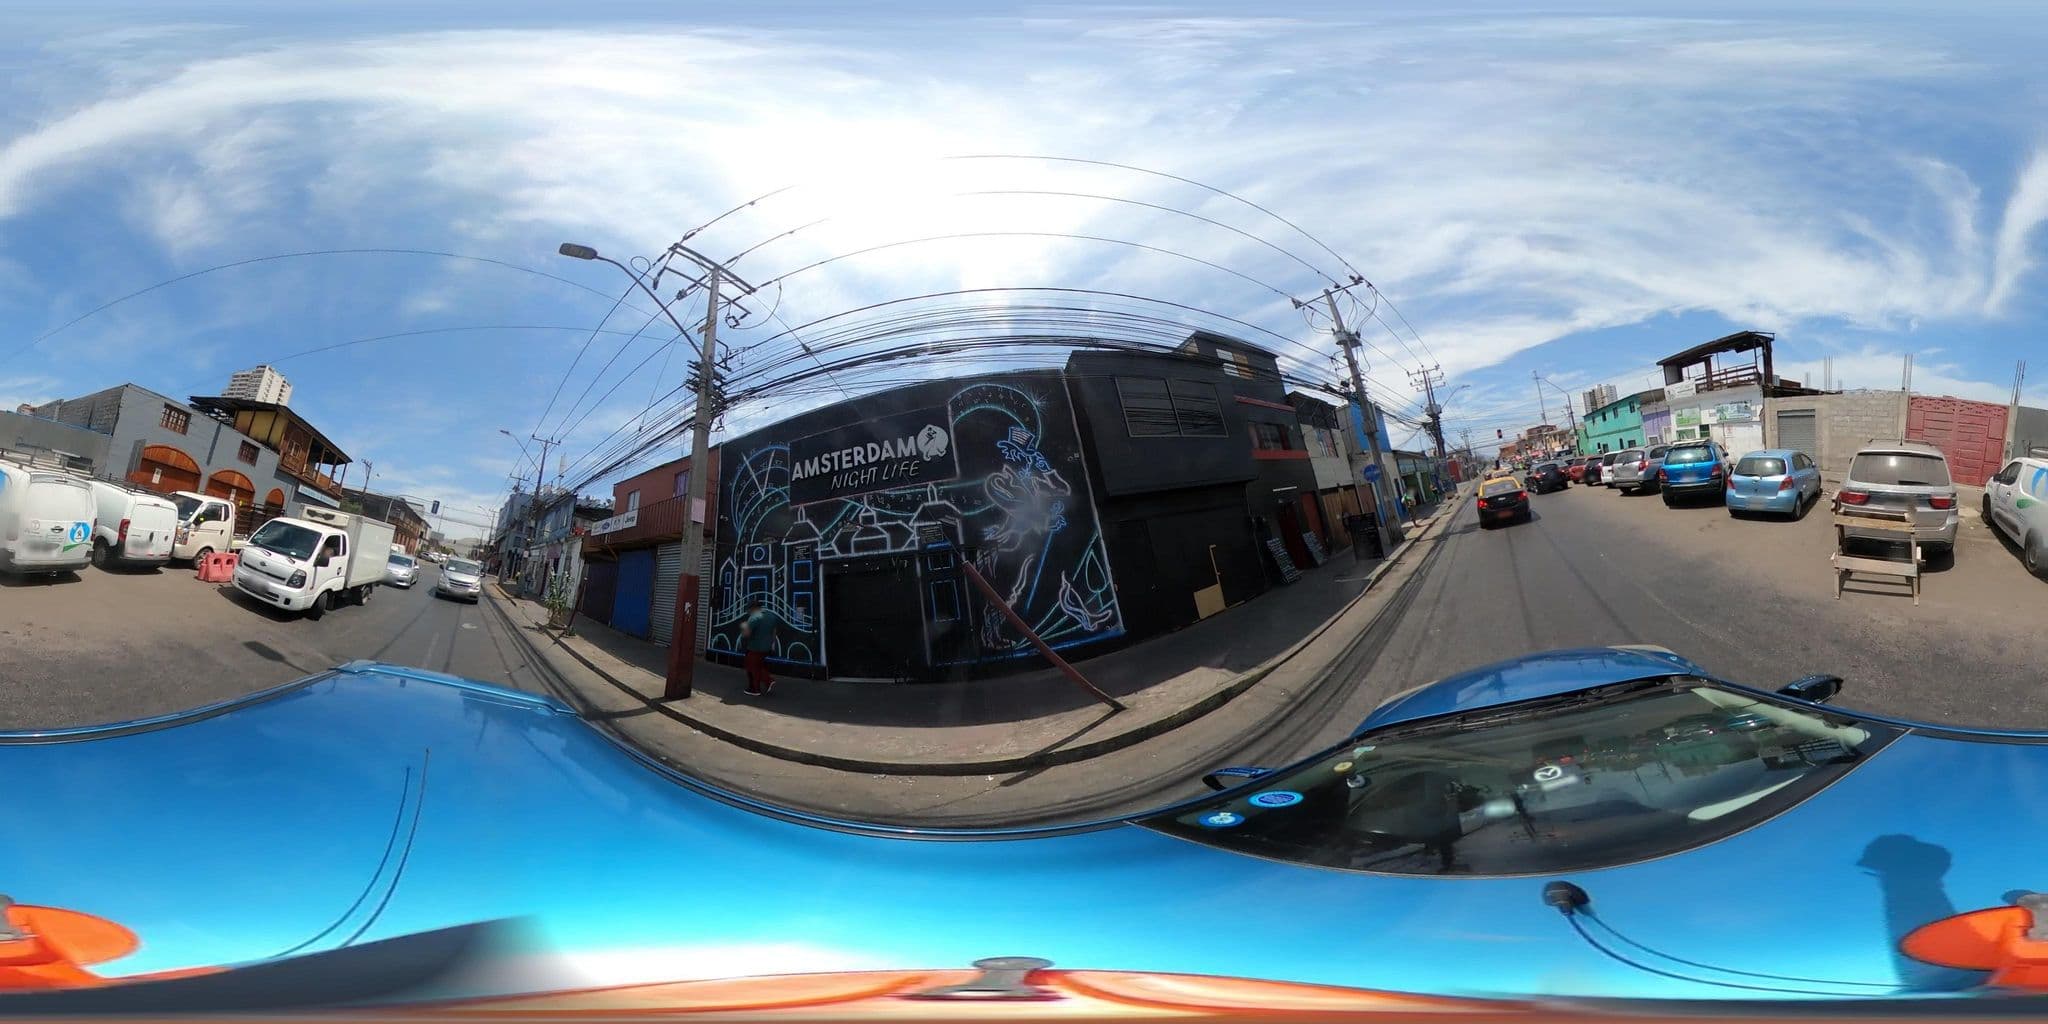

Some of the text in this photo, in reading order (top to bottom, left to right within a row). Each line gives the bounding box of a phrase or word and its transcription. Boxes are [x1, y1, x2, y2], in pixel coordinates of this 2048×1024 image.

[792, 436, 917, 481] AMSTERDAM
[831, 460, 920, 490] NIGHT LIFE
